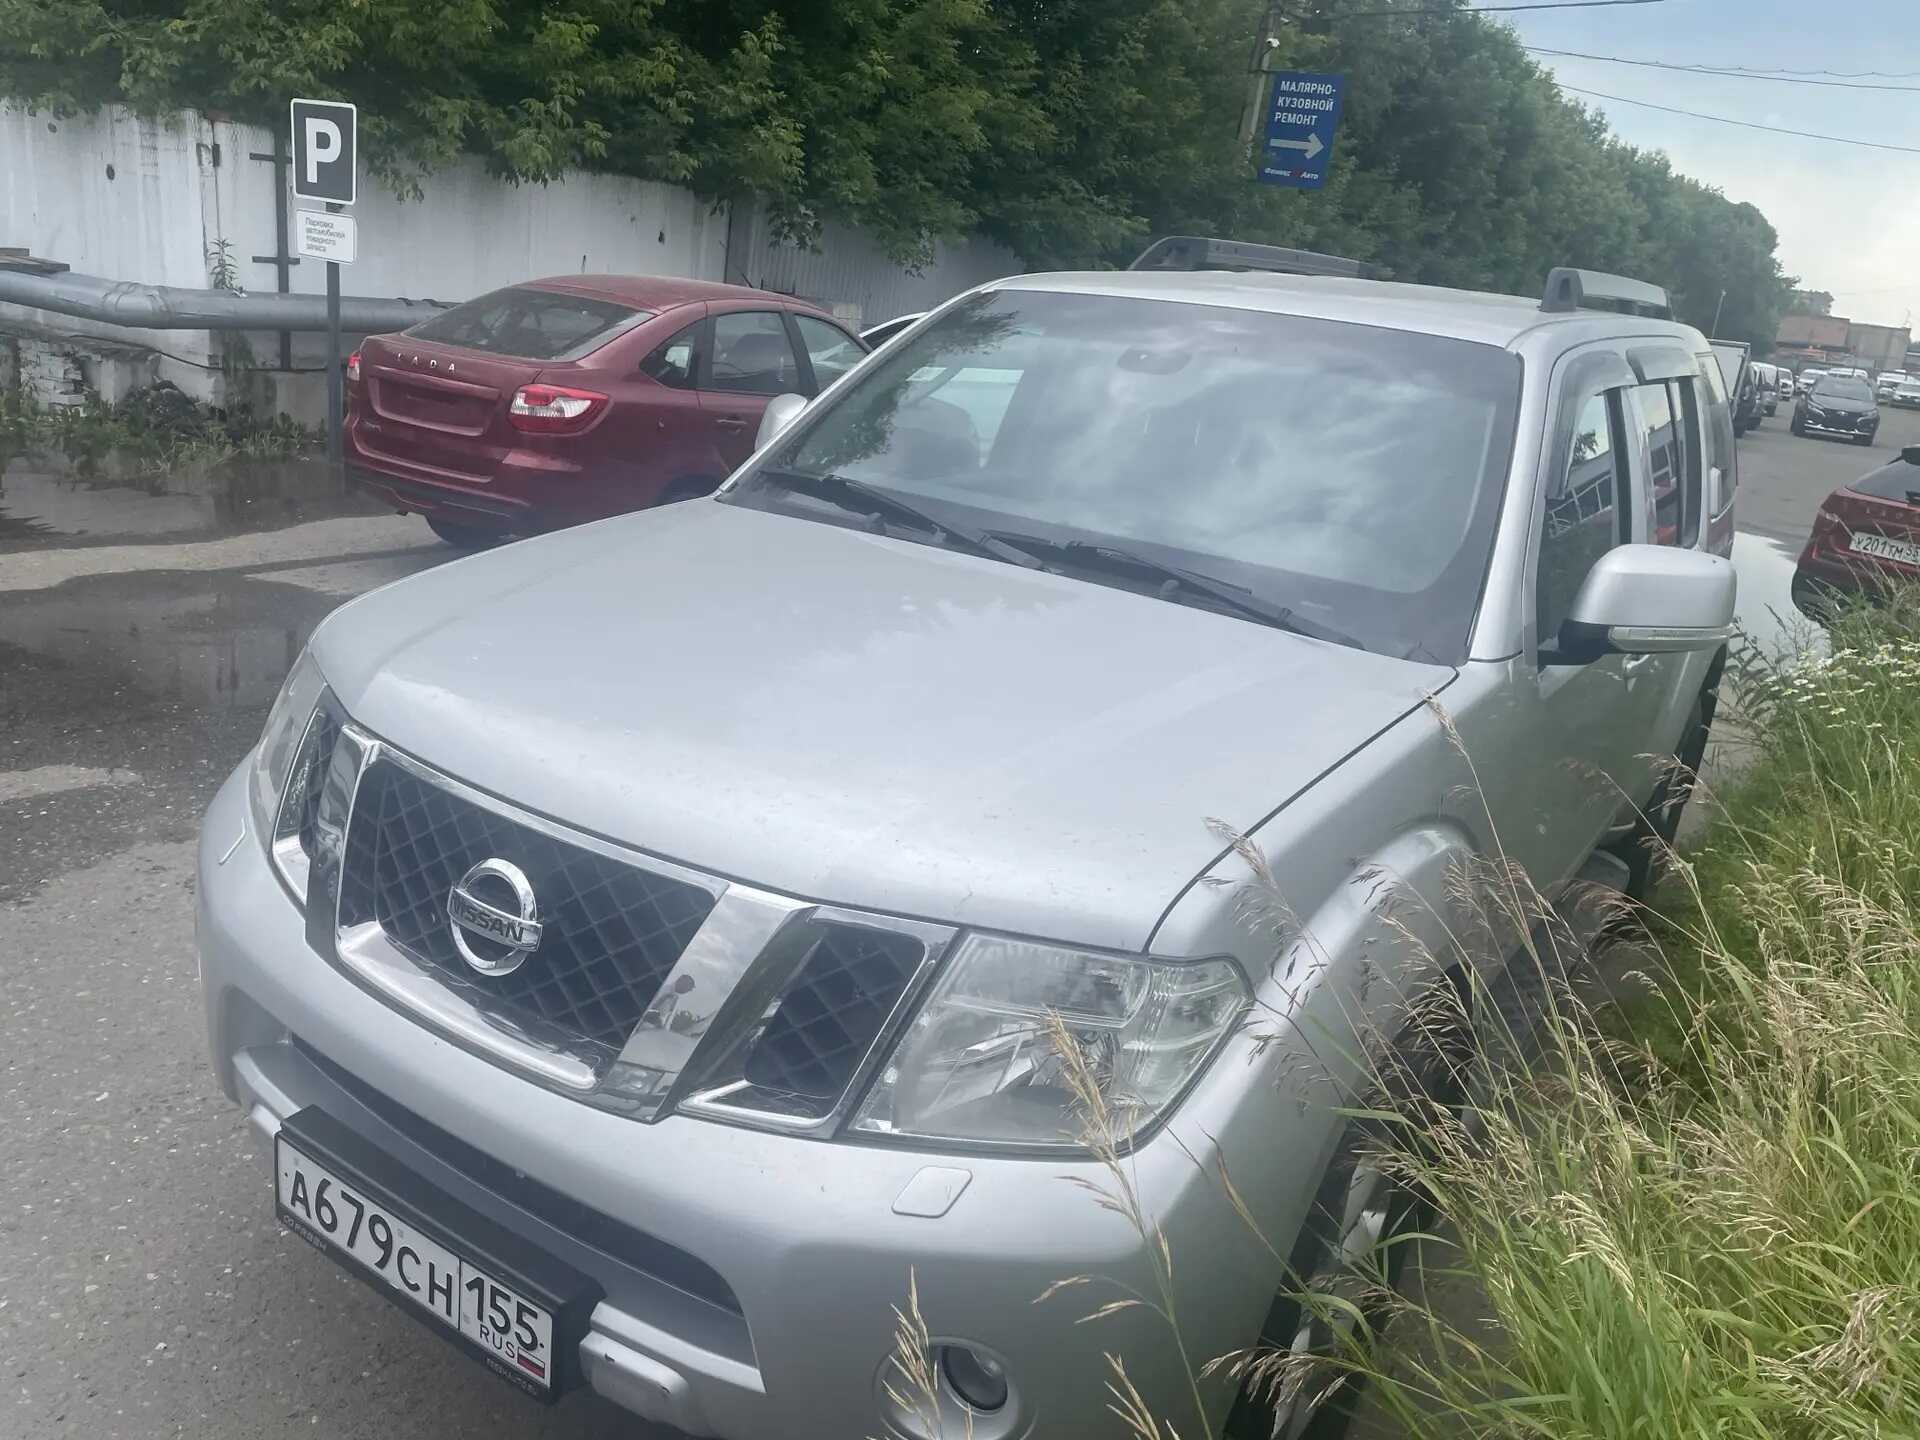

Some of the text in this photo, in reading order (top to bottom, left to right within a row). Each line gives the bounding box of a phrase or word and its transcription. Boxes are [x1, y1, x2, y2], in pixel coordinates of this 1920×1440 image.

[1280, 81, 1336, 95] МАЛЯРНО-
[1277, 96, 1334, 111] КУЗОВНОЙ
[1274, 112, 1318, 126] РЕМОНТ
[305, 117, 342, 184] P
[465, 1276, 538, 1351] 155
[479, 1323, 516, 1359] RUS
